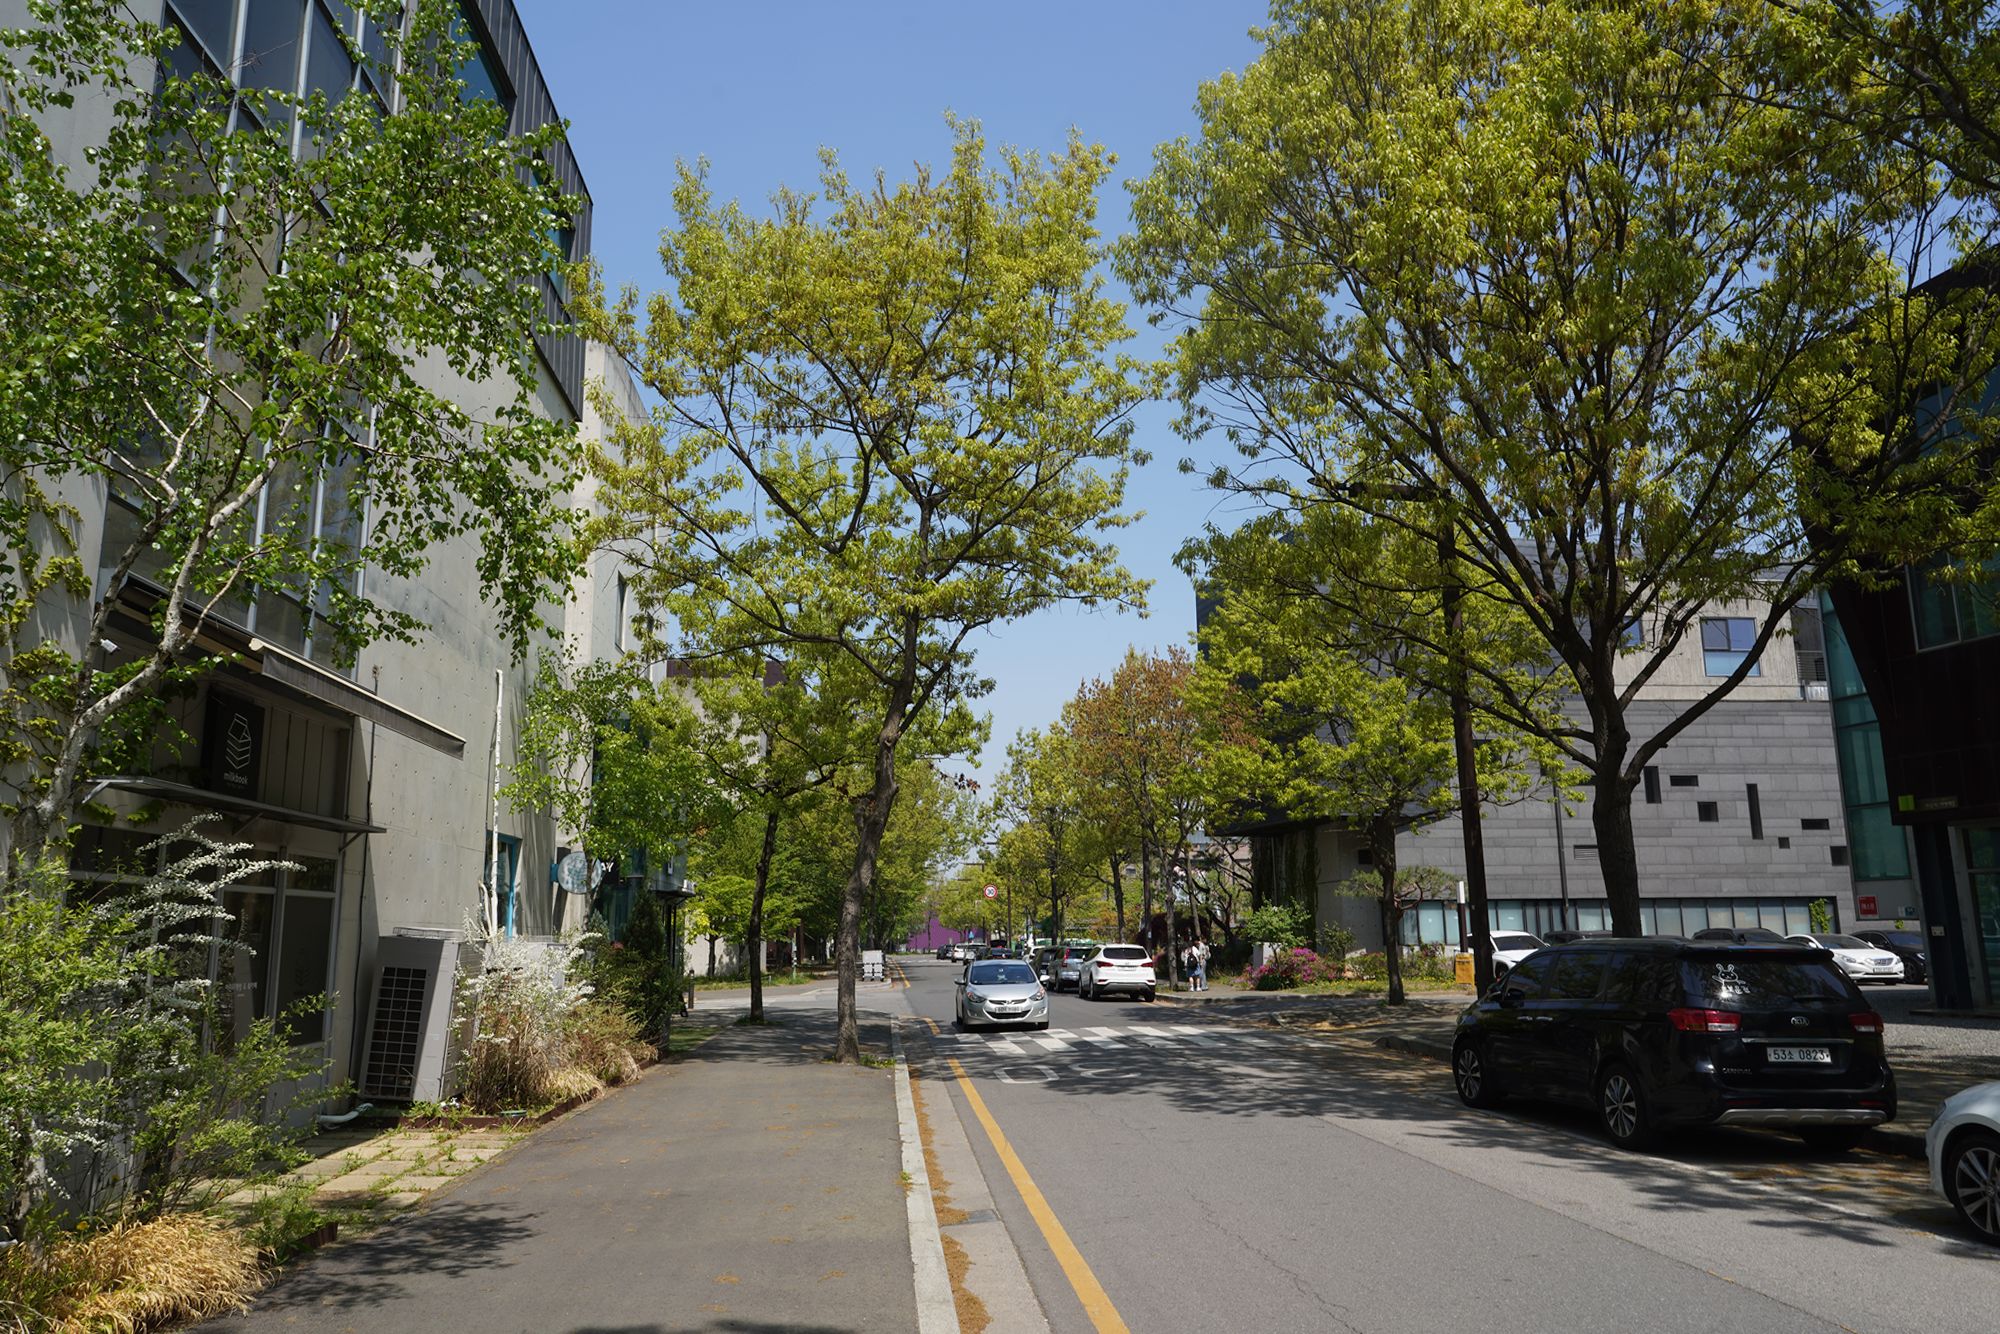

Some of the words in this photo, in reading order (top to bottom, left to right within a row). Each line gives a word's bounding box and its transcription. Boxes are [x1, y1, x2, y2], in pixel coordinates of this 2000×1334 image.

[224, 771, 249, 786] milkbook
[987, 888, 995, 896] 30
[1722, 984, 1751, 997] 보운전
[1793, 1016, 1809, 1026] KIA
[1773, 1049, 1794, 1060] 53소
[1799, 1049, 1825, 1061] 0823
